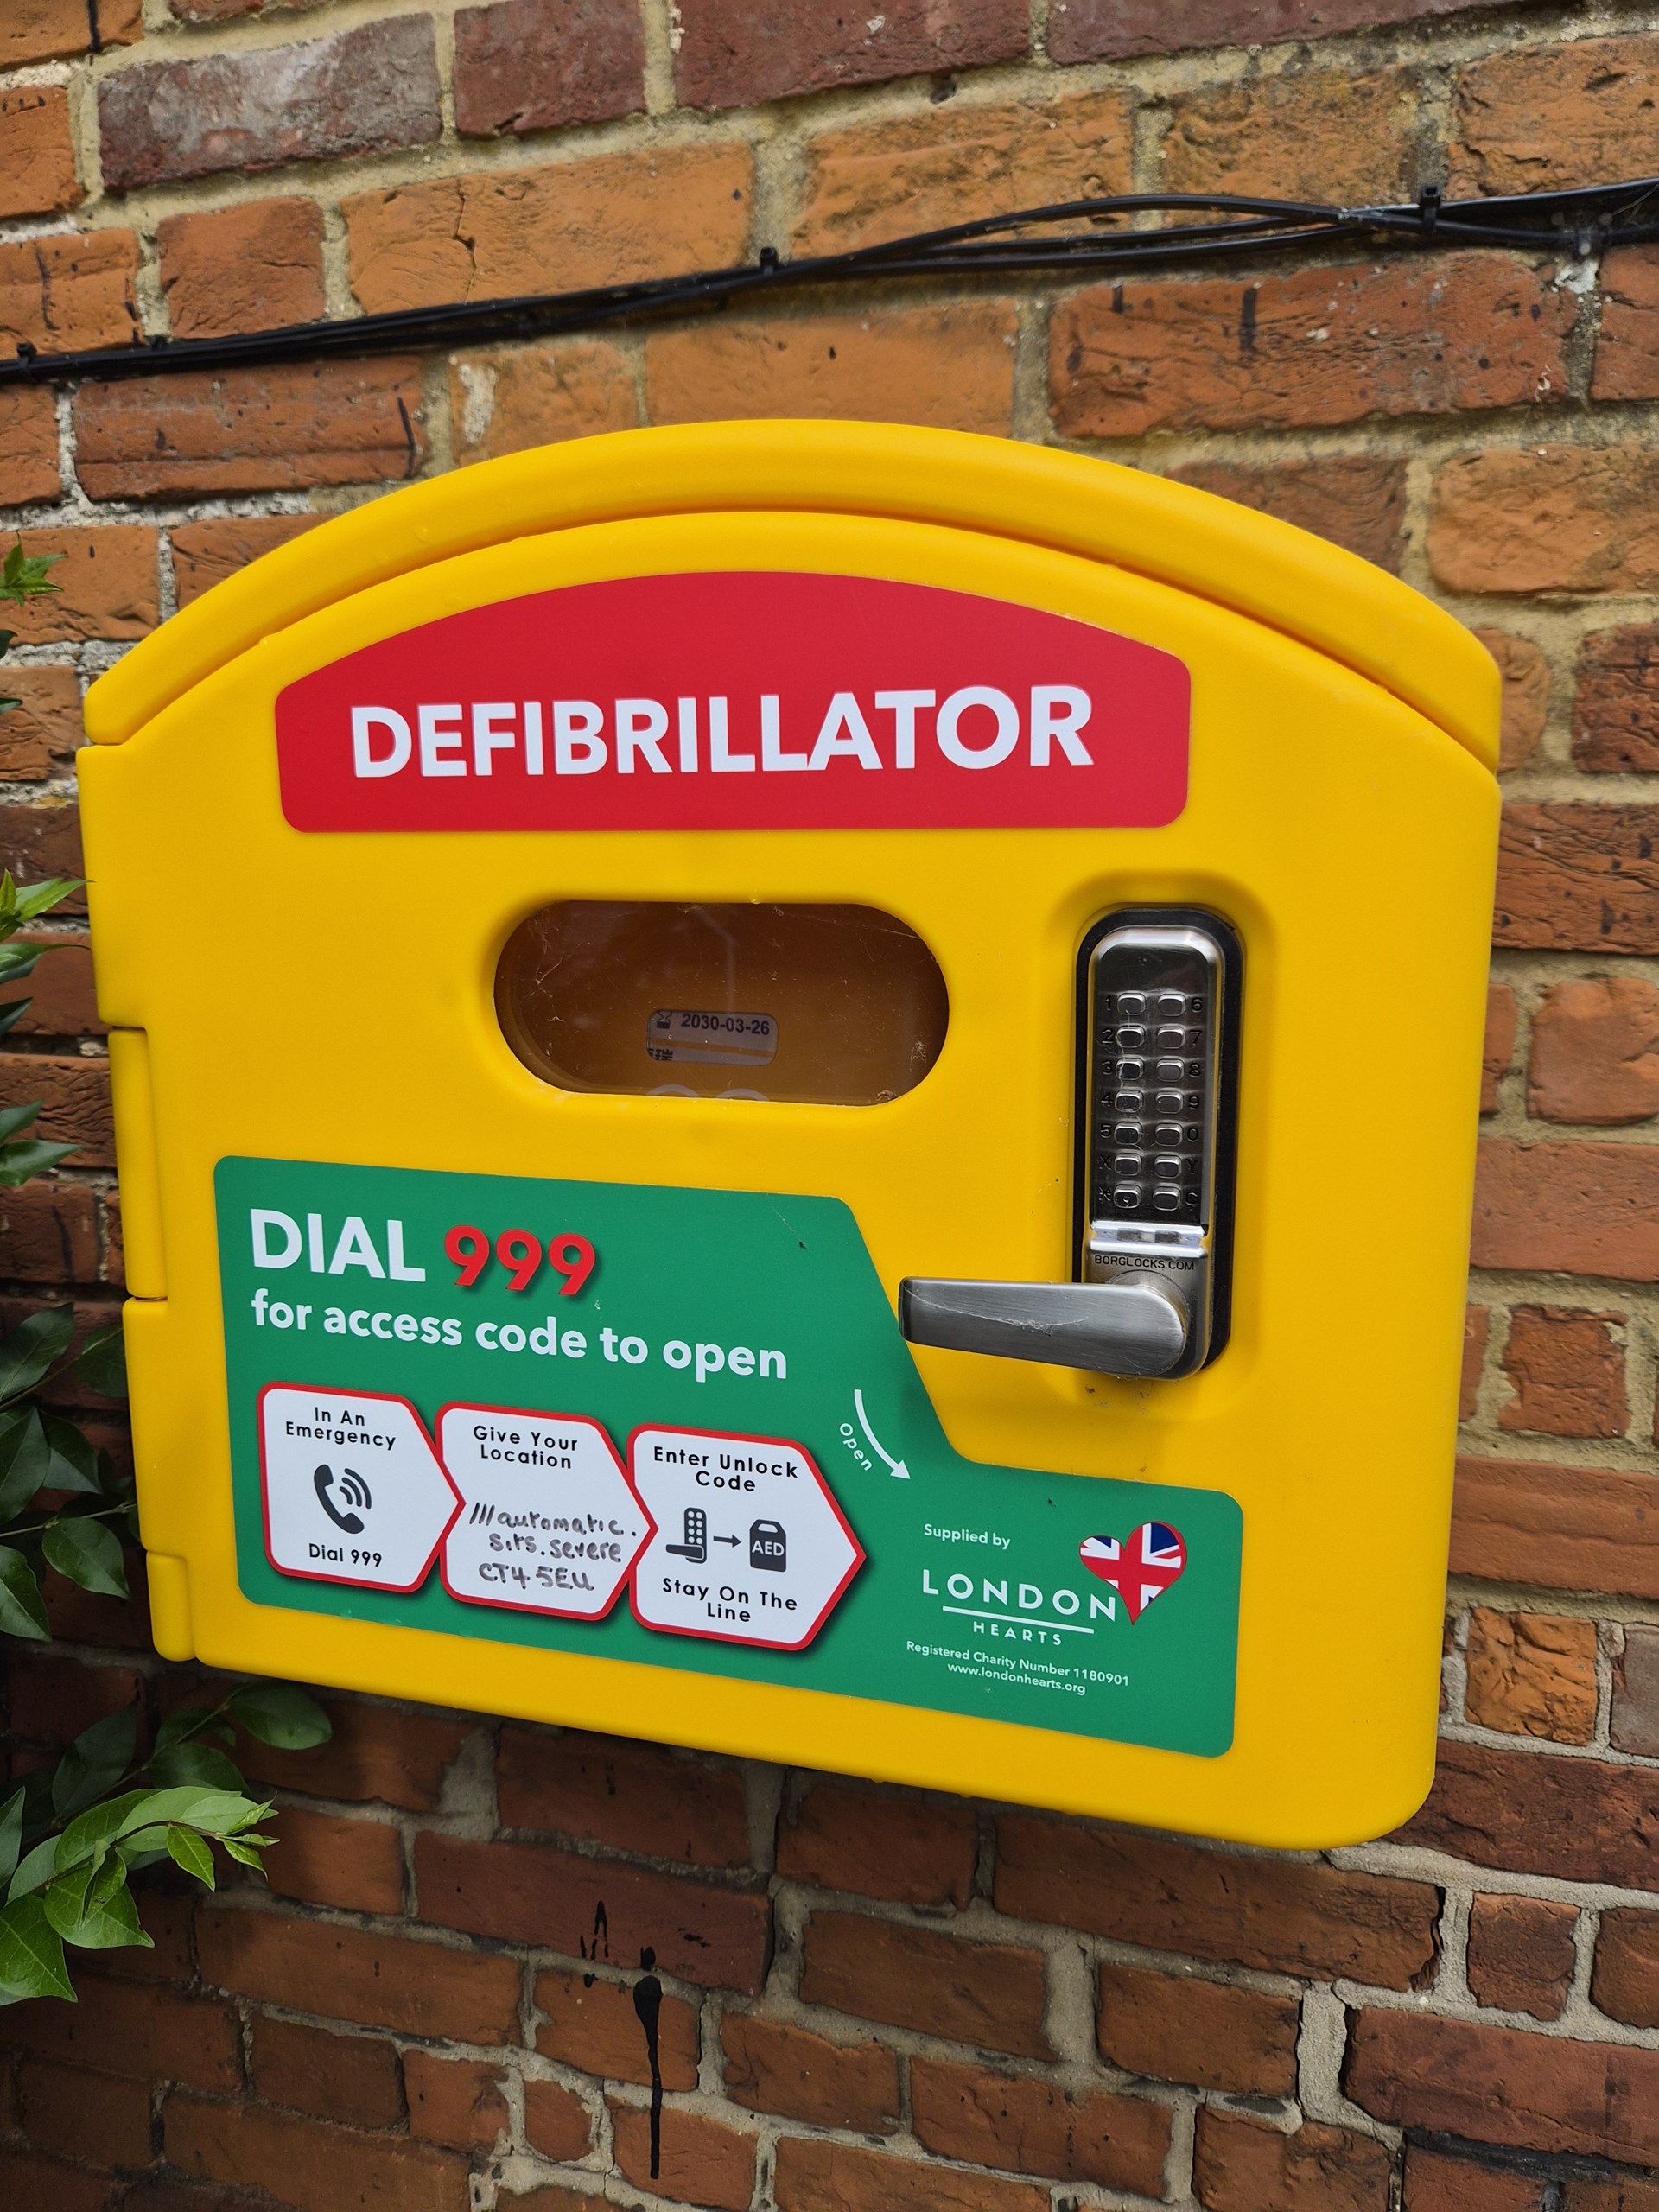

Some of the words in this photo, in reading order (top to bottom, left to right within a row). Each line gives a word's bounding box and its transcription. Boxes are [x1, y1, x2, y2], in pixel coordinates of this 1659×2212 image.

[352, 684, 1094, 779] DEFIBRILLATOR
[1104, 995, 1112, 1011] 1
[1191, 997, 1203, 1013] 6
[681, 1013, 770, 1035] 2030-03-26
[1101, 1028, 1114, 1044] 2
[1189, 1030, 1202, 1046] 7
[1102, 1060, 1113, 1075] 3
[1189, 1063, 1201, 1077] 8
[1100, 1092, 1113, 1107] 4
[1188, 1095, 1200, 1110] 9
[1100, 1124, 1111, 1138] 5
[1099, 1154, 1111, 1169] X
[1185, 1159, 1198, 1174] Y
[1185, 1192, 1198, 1206] C
[251, 1208, 427, 1282] DIAL
[444, 1224, 596, 1296] 999
[1094, 1255, 1195, 1271] BORGLOCKS.COM
[251, 1288, 313, 1331] for
[324, 1306, 463, 1345] access
[475, 1316, 588, 1358] code
[600, 1328, 648, 1363] to
[663, 1340, 787, 1382] open
[315, 1407, 332, 1422] In
[340, 1410, 365, 1426] An
[285, 1421, 397, 1451] Emergency
[474, 1425, 521, 1444] Give
[531, 1432, 578, 1451] Your
[480, 1445, 571, 1469] Location
[840, 1423, 873, 1471] Open
[653, 1446, 709, 1467] Enter
[719, 1454, 798, 1478] Unlock
[696, 1471, 756, 1491] Code
[924, 1523, 988, 1545] Supplied
[993, 1532, 1011, 1550] by
[308, 1543, 344, 1562] Dial
[351, 1549, 383, 1567] 999
[751, 1540, 785, 1557] AED
[479, 1562, 531, 1590] CT4
[662, 1577, 709, 1600] Stay
[719, 1586, 749, 1604] On
[760, 1592, 798, 1611] The
[922, 1569, 1116, 1621] LONDON
[707, 1602, 751, 1622] Line
[973, 1621, 1063, 1645] HEARTS
[906, 1641, 970, 1660] Registered
[973, 1651, 1017, 1669] Charity
[1020, 1659, 1071, 1677] Number
[1073, 1668, 1129, 1687] 1180901
[947, 1662, 1086, 1695] www.londonhearts.org
